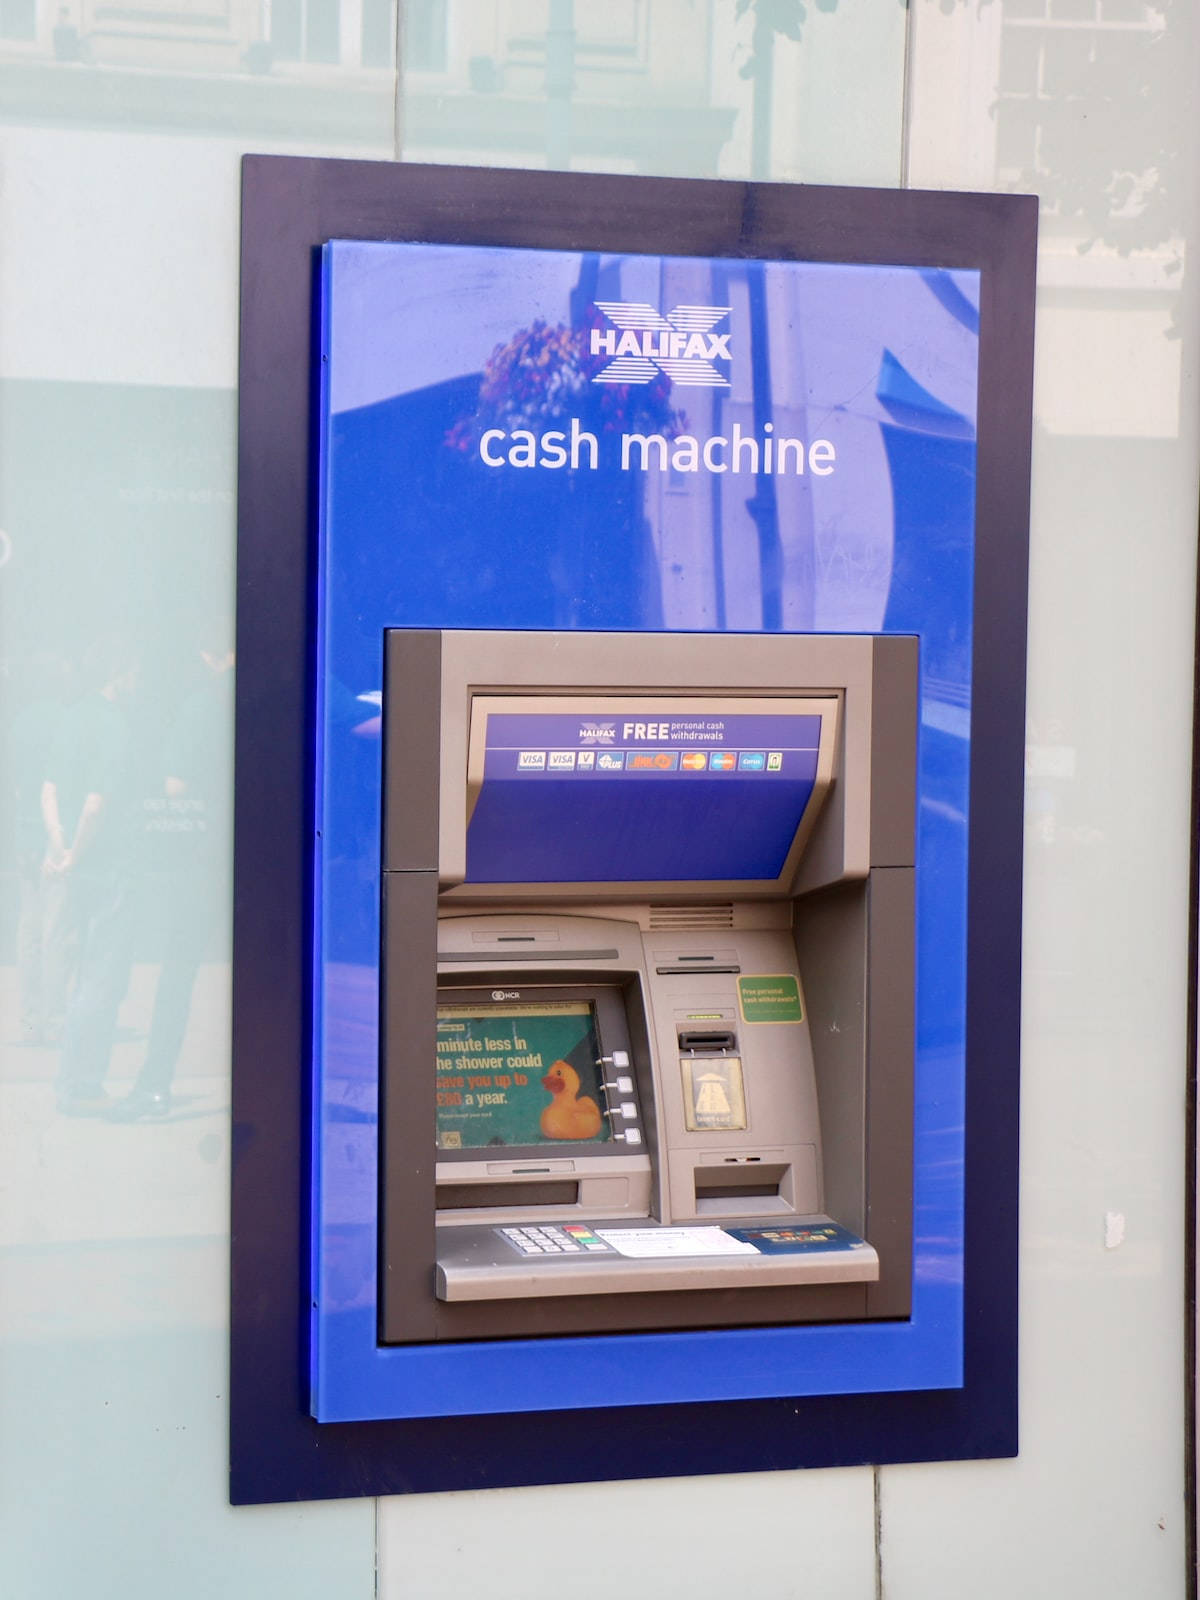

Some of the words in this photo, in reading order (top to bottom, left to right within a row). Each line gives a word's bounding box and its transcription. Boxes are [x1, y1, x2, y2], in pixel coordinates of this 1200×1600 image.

[590, 328, 733, 360] HALIFAX
[479, 418, 598, 470] cash
[621, 423, 835, 476] machine
[579, 729, 616, 737] HALIFAX
[623, 722, 670, 740] FREE
[671, 721, 705, 731] personal
[706, 721, 725, 730] cash
[670, 730, 724, 740] withdrawals
[522, 755, 543, 763] VISA
[552, 755, 573, 763] VISA
[436, 1037, 482, 1052] minute
[484, 1036, 511, 1051] less
[514, 1035, 527, 1050] in
[436, 1056, 453, 1070] he
[455, 1055, 504, 1070] shower
[506, 1053, 543, 1068] could
[468, 1075, 492, 1091] you
[494, 1074, 512, 1089] up
[513, 1071, 528, 1087] to
[464, 1093, 474, 1105] a
[476, 1092, 508, 1108] year.
